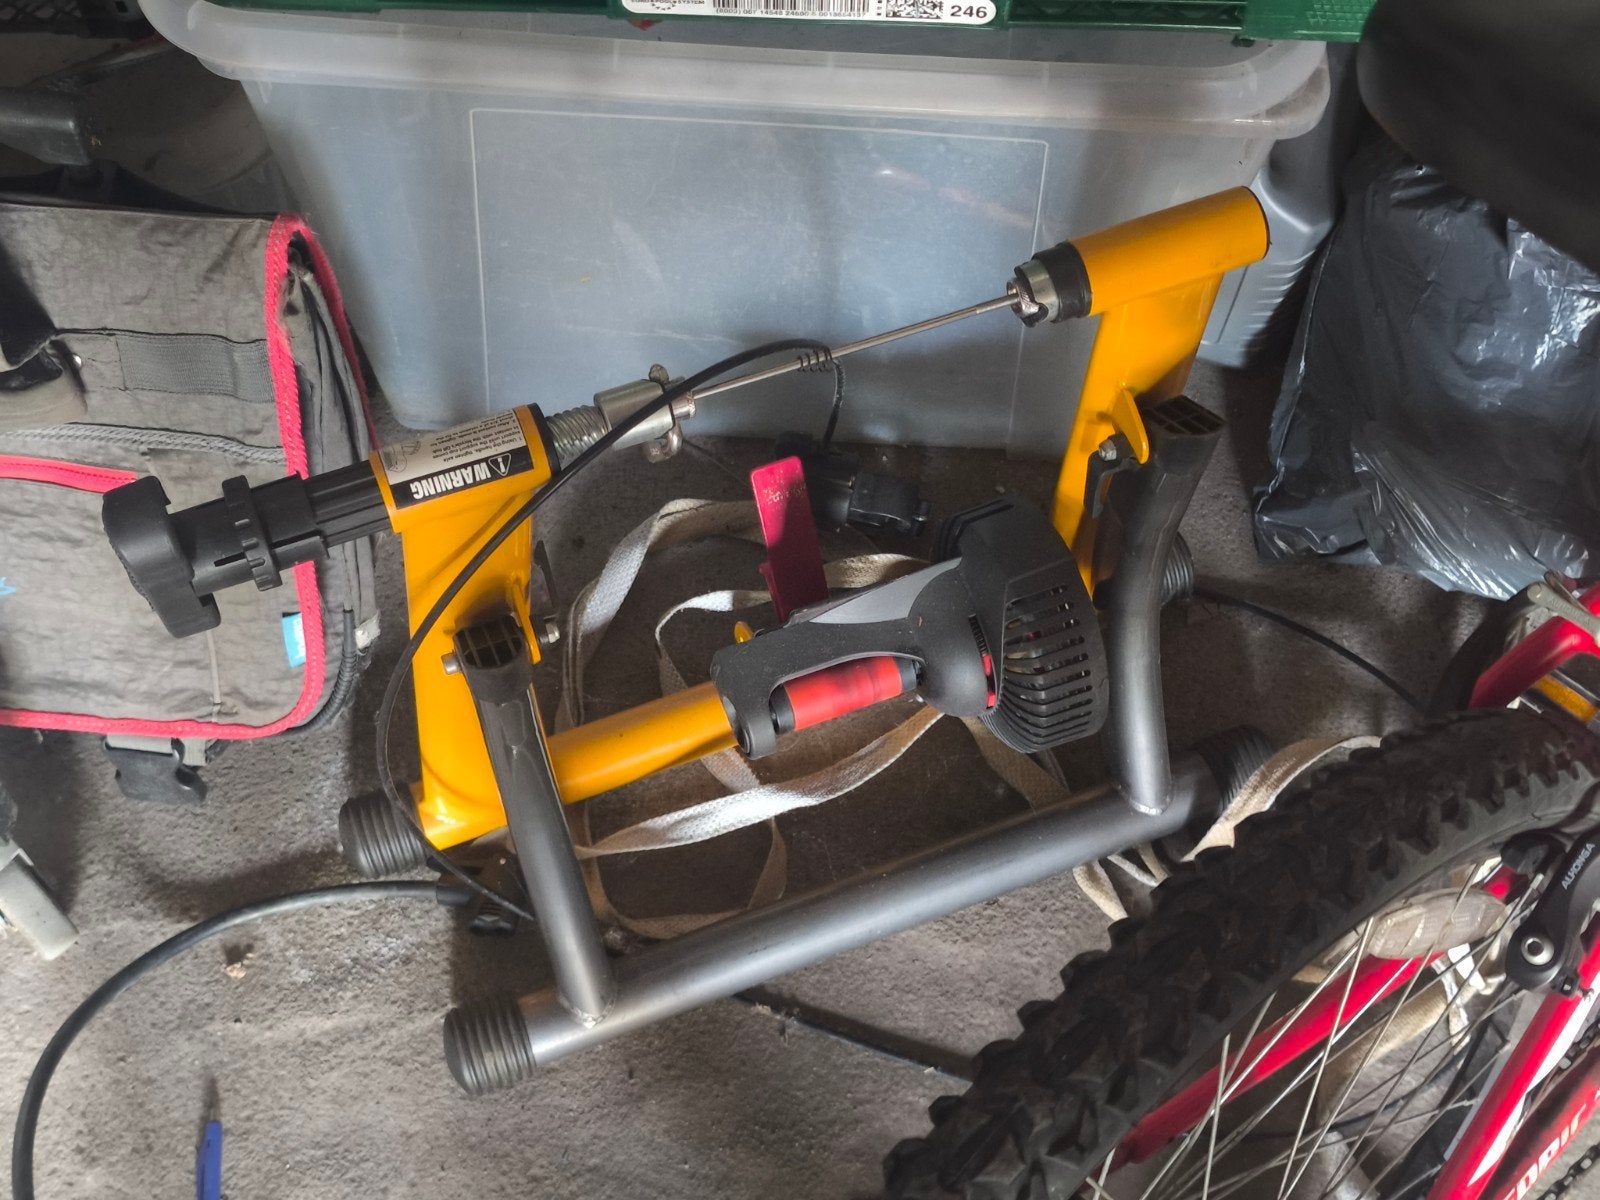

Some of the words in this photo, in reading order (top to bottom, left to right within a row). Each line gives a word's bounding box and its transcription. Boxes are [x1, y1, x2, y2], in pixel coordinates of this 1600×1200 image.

[950, 5, 988, 18] 246
[410, 462, 492, 500] WARNING
[1562, 843, 1596, 890] ALHONGA
